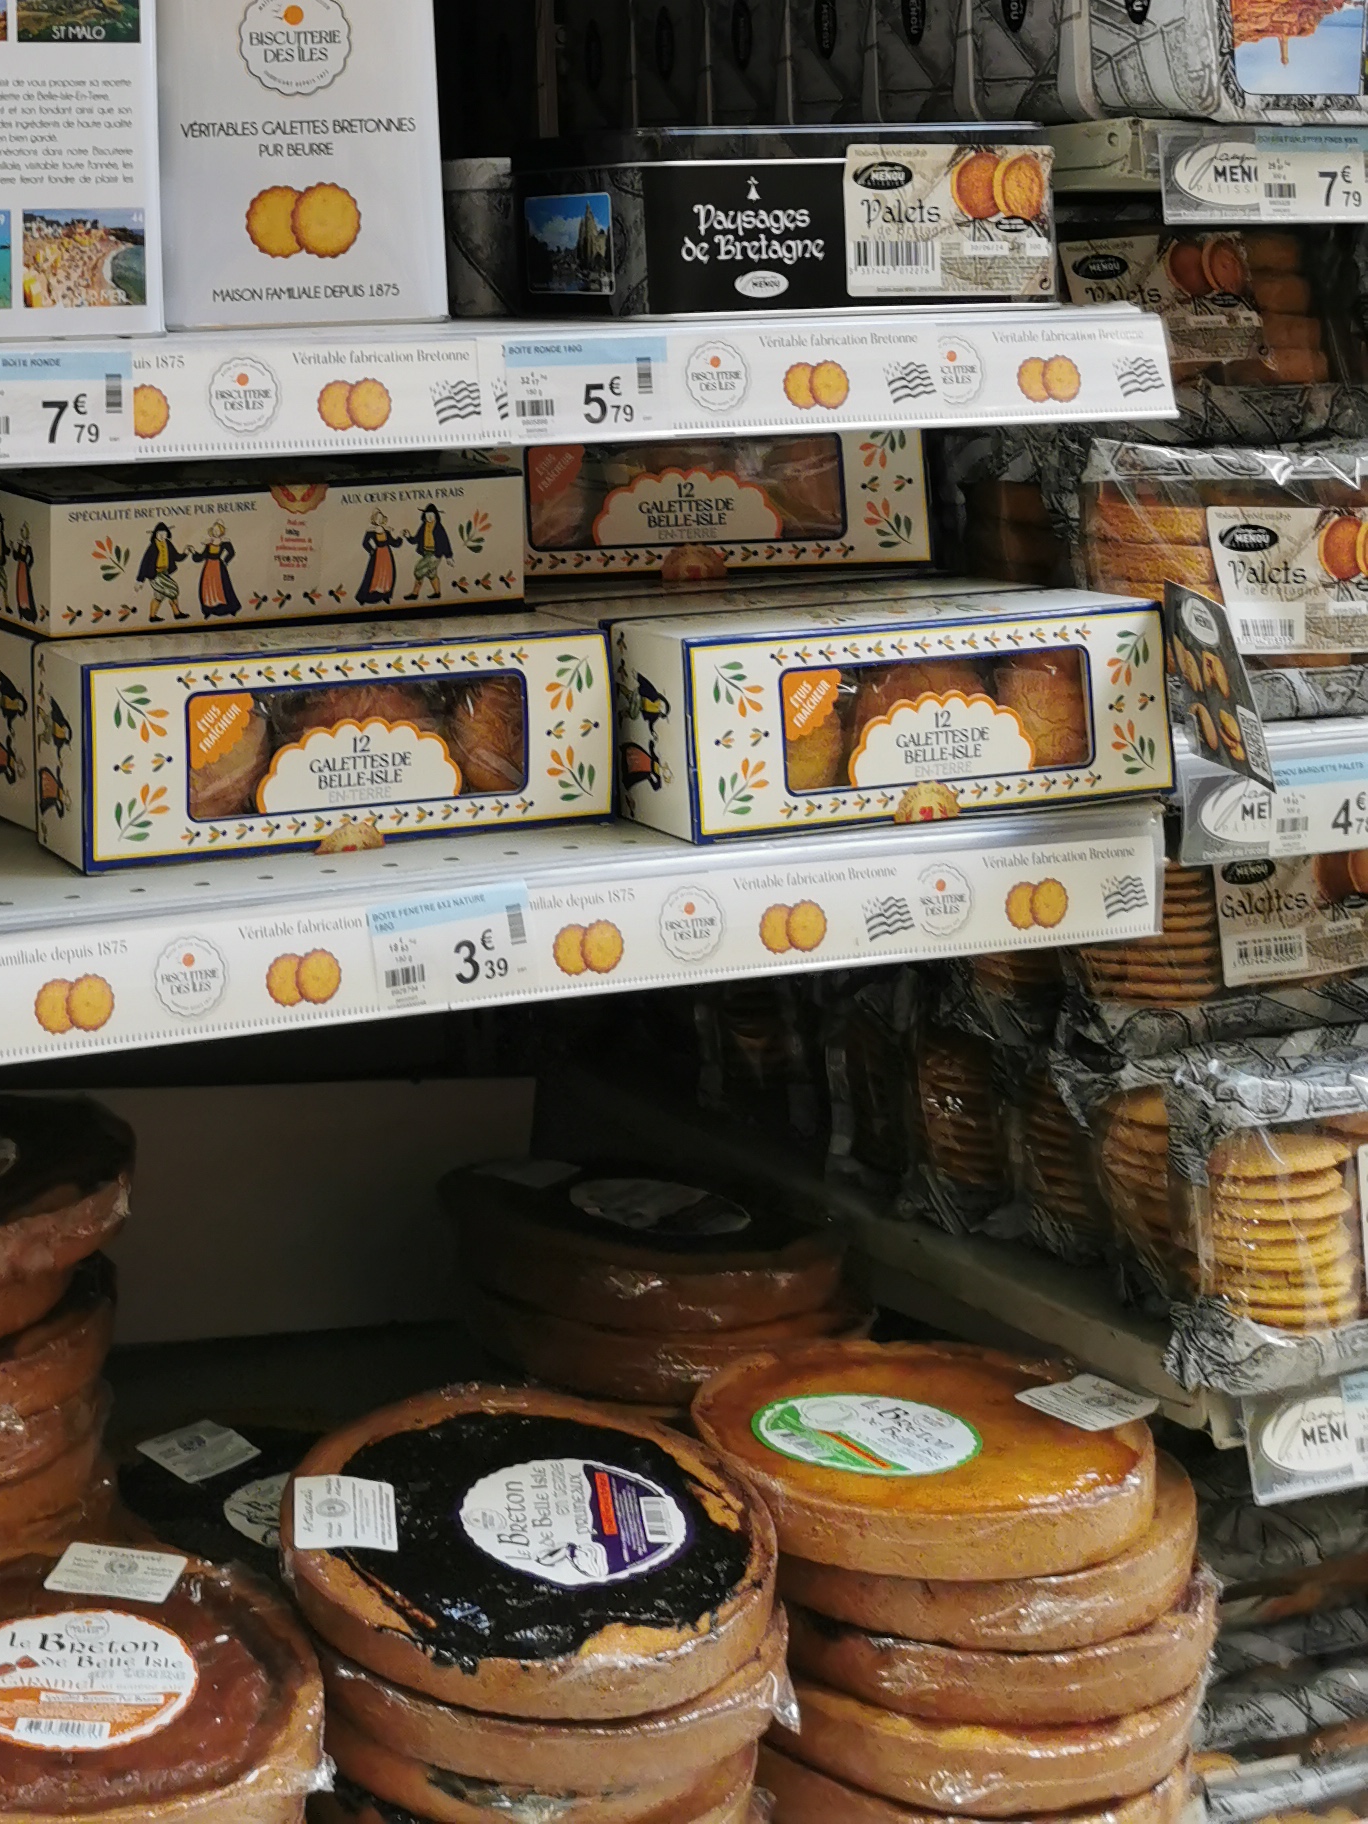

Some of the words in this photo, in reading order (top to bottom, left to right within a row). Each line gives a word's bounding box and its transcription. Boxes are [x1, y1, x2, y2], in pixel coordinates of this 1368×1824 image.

[52, 26, 66, 39] ST
[68, 26, 106, 40] MALO
[249, 29, 341, 51] BISCUITERIE
[263, 47, 295, 64] DES
[179, 121, 259, 139] VÉRITABLES
[261, 119, 330, 136] GALETTES
[332, 117, 416, 134] BRETONNES
[258, 143, 284, 157] PUR
[286, 142, 334, 157] BEURRE
[875, 167, 906, 181] MENOU
[1341, 166, 1353, 184] €
[1318, 171, 1338, 207] 7
[1342, 190, 1363, 207] 79
[693, 204, 811, 236] Paysages
[860, 198, 942, 229] Palets
[681, 233, 710, 263] de
[716, 233, 826, 263] Bretagne
[212, 288, 263, 303] MAISON
[265, 285, 321, 301] FAMILIALE
[323, 284, 365, 299] DEPUIS
[368, 283, 400, 298] 1875
[508, 345, 540, 355] BOITE
[533, 345, 562, 354] RONDE
[1, 358, 28, 368] BOITE
[608, 376, 622, 397] €
[73, 392, 88, 416] €
[584, 383, 608, 424] 5
[609, 403, 634, 424] 79
[41, 400, 68, 444] 7
[73, 424, 100, 444] 79
[340, 493, 362, 505] AUX
[398, 488, 434, 502] EXTRA
[435, 486, 465, 499] FRAIS
[676, 482, 695, 499] 12
[67, 508, 132, 523] SPÉCIALITÉ
[133, 504, 192, 519] BRETONNE
[193, 503, 215, 515] PUR
[217, 500, 258, 514] BEURRE
[638, 498, 708, 518] GALETTES
[703, 497, 735, 512] DE
[647, 512, 727, 529] BELLE-ISLE
[934, 710, 952, 729] 12
[353, 734, 371, 754] 12
[895, 728, 970, 753] GALETTES
[970, 726, 990, 742] DE
[903, 740, 982, 765] BELLE-ISLE
[309, 752, 390, 780] GALETTES
[391, 751, 412, 767] DE
[317, 766, 403, 790] BELLE-ISLE
[1332, 798, 1352, 835] 4
[1356, 791, 1366, 811] €
[371, 910, 398, 923] BOITE
[398, 903, 436, 917] FENETRE
[452, 894, 486, 907] NATURE
[481, 929, 494, 951] €
[454, 940, 481, 984] 3
[485, 956, 508, 979] 39
